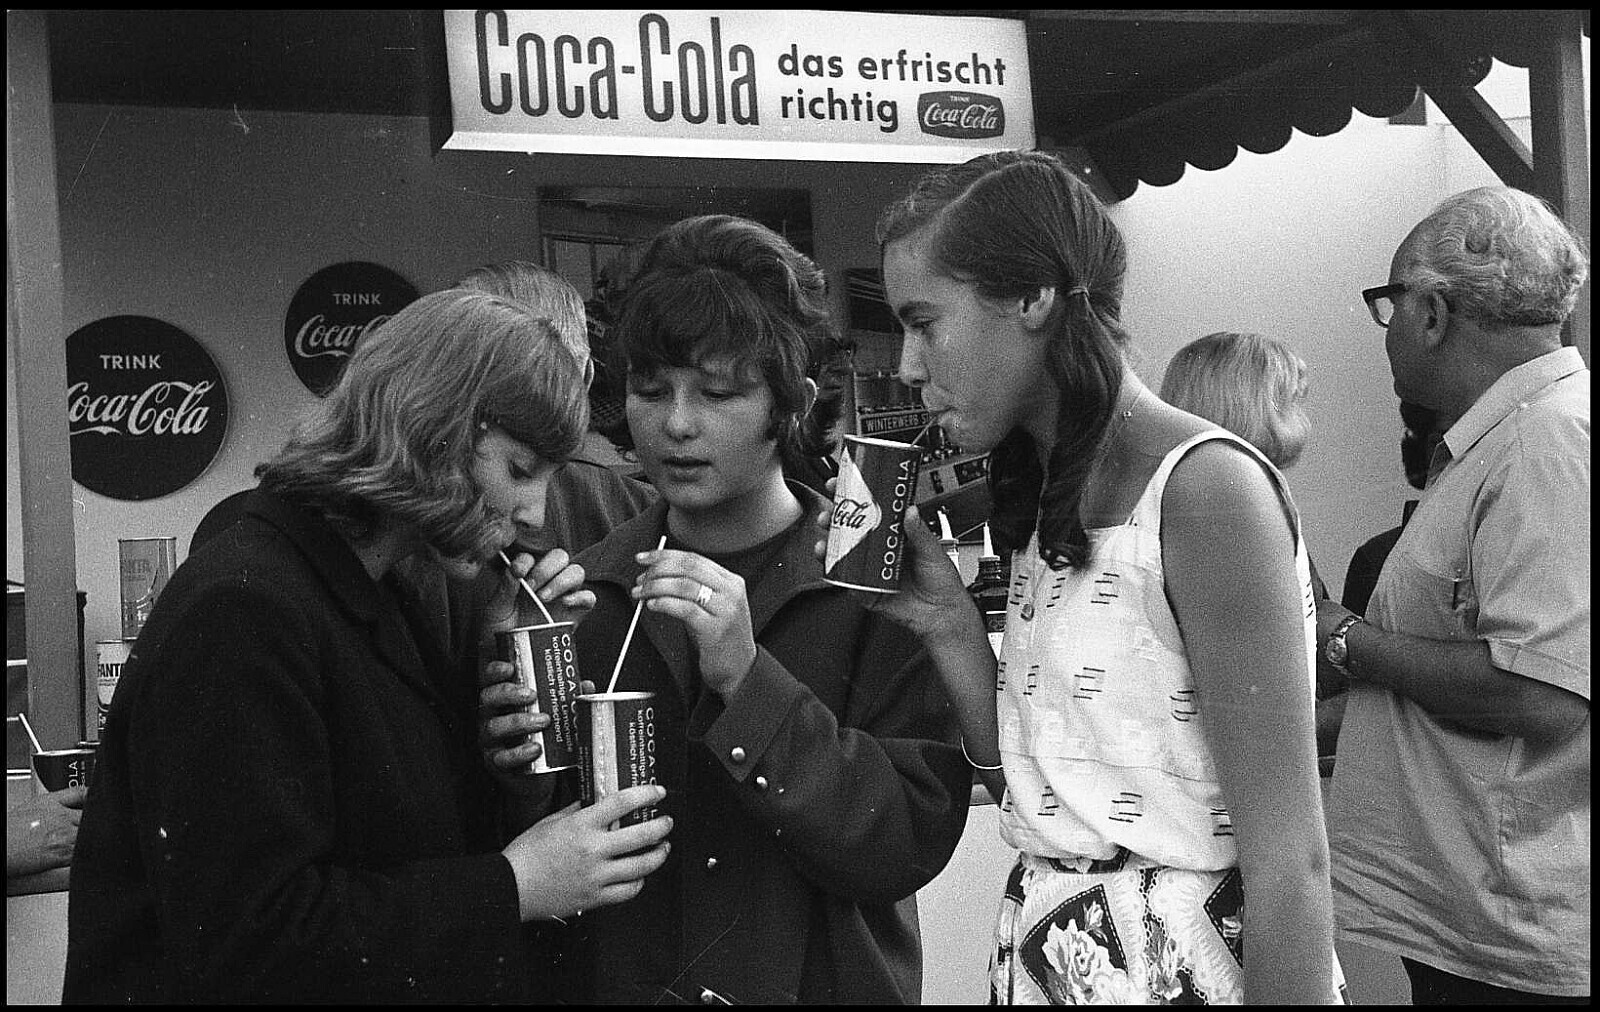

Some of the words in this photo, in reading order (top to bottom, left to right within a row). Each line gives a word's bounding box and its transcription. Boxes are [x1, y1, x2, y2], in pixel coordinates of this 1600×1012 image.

[474, 9, 760, 126] Coca-Cola
[777, 44, 844, 77] das
[858, 45, 1007, 87] erfrischt
[780, 88, 899, 133] richtig
[924, 102, 999, 130] Coca-Cola
[333, 293, 382, 305] TRINK
[99, 354, 162, 370] TRINK
[881, 459, 912, 581] COCA-COLA
